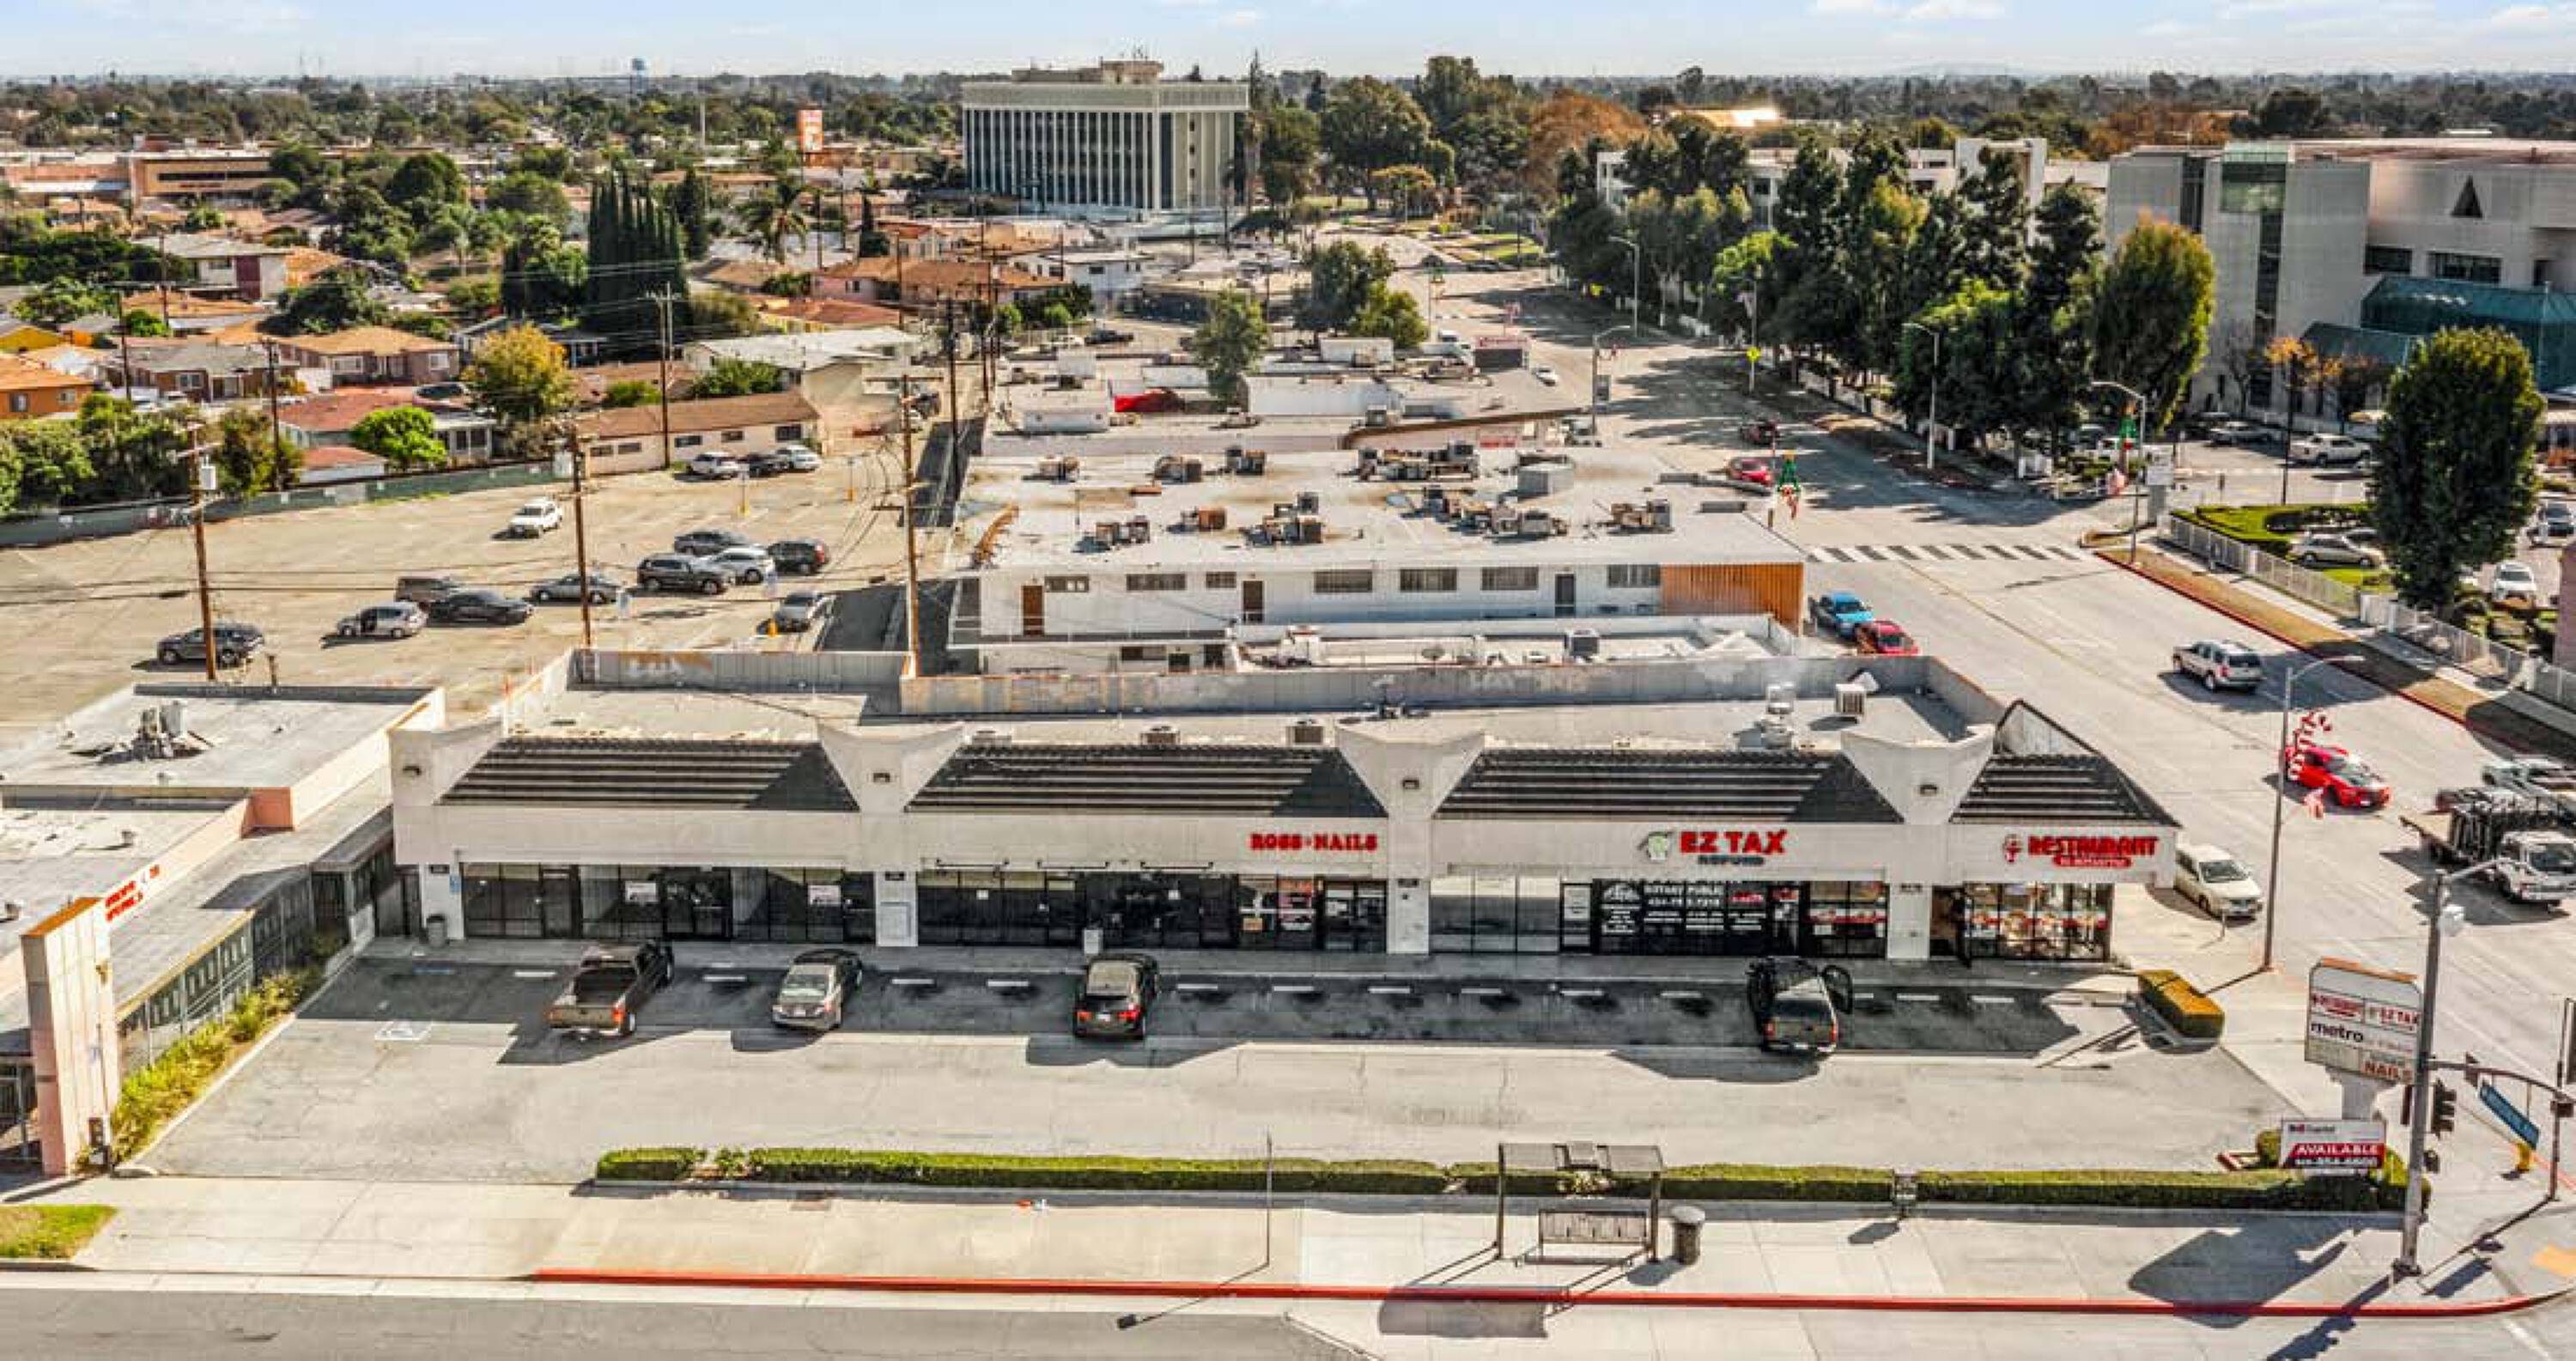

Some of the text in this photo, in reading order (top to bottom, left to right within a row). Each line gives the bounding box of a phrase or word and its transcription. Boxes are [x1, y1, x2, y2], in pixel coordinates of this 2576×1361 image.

[1313, 833, 1378, 852] NAILS
[1680, 829, 1788, 854] EZ TAX
[2027, 835, 2160, 856] RESTAURANT
[2310, 1022, 2365, 1043] metro
[2295, 1143, 2379, 1156] AVAILABLE
